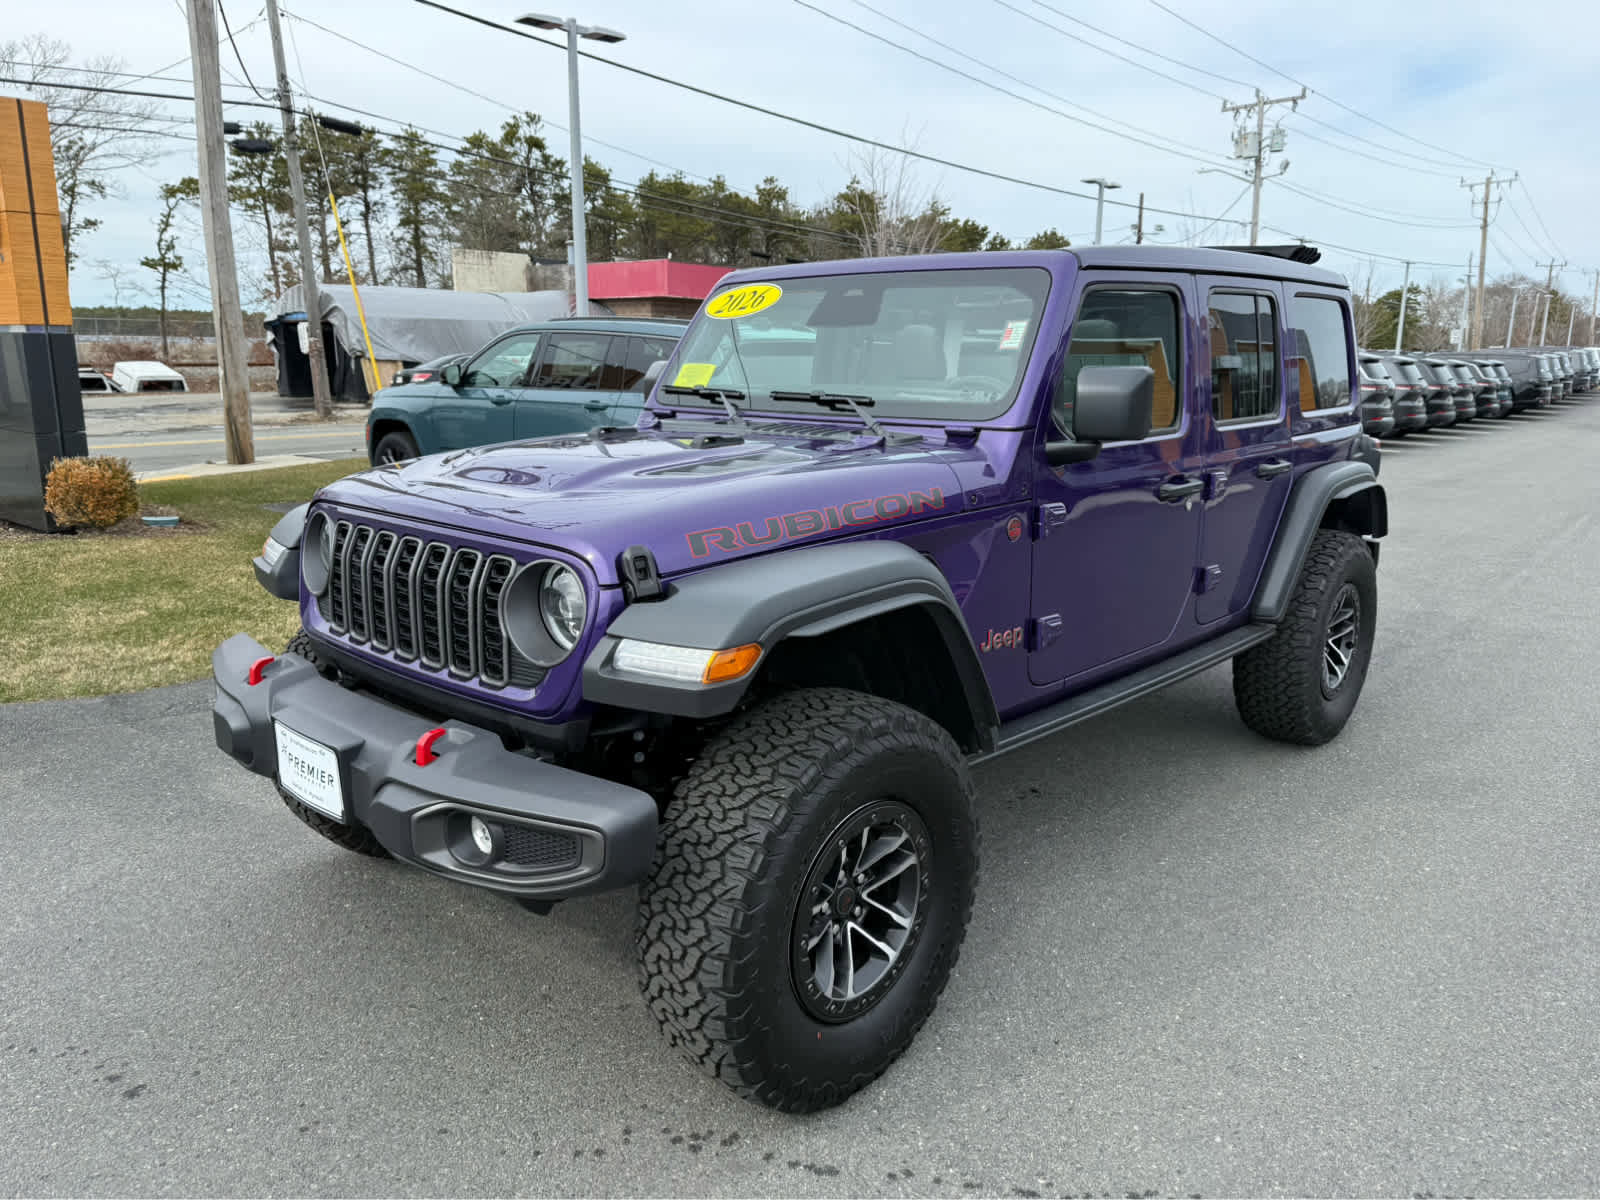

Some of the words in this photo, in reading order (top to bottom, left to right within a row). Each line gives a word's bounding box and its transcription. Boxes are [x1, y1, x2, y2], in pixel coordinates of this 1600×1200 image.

[714, 288, 774, 314] 2026
[685, 487, 945, 559] RUBICON
[980, 627, 1022, 653] Jeep
[288, 752, 334, 786] PREMIER
